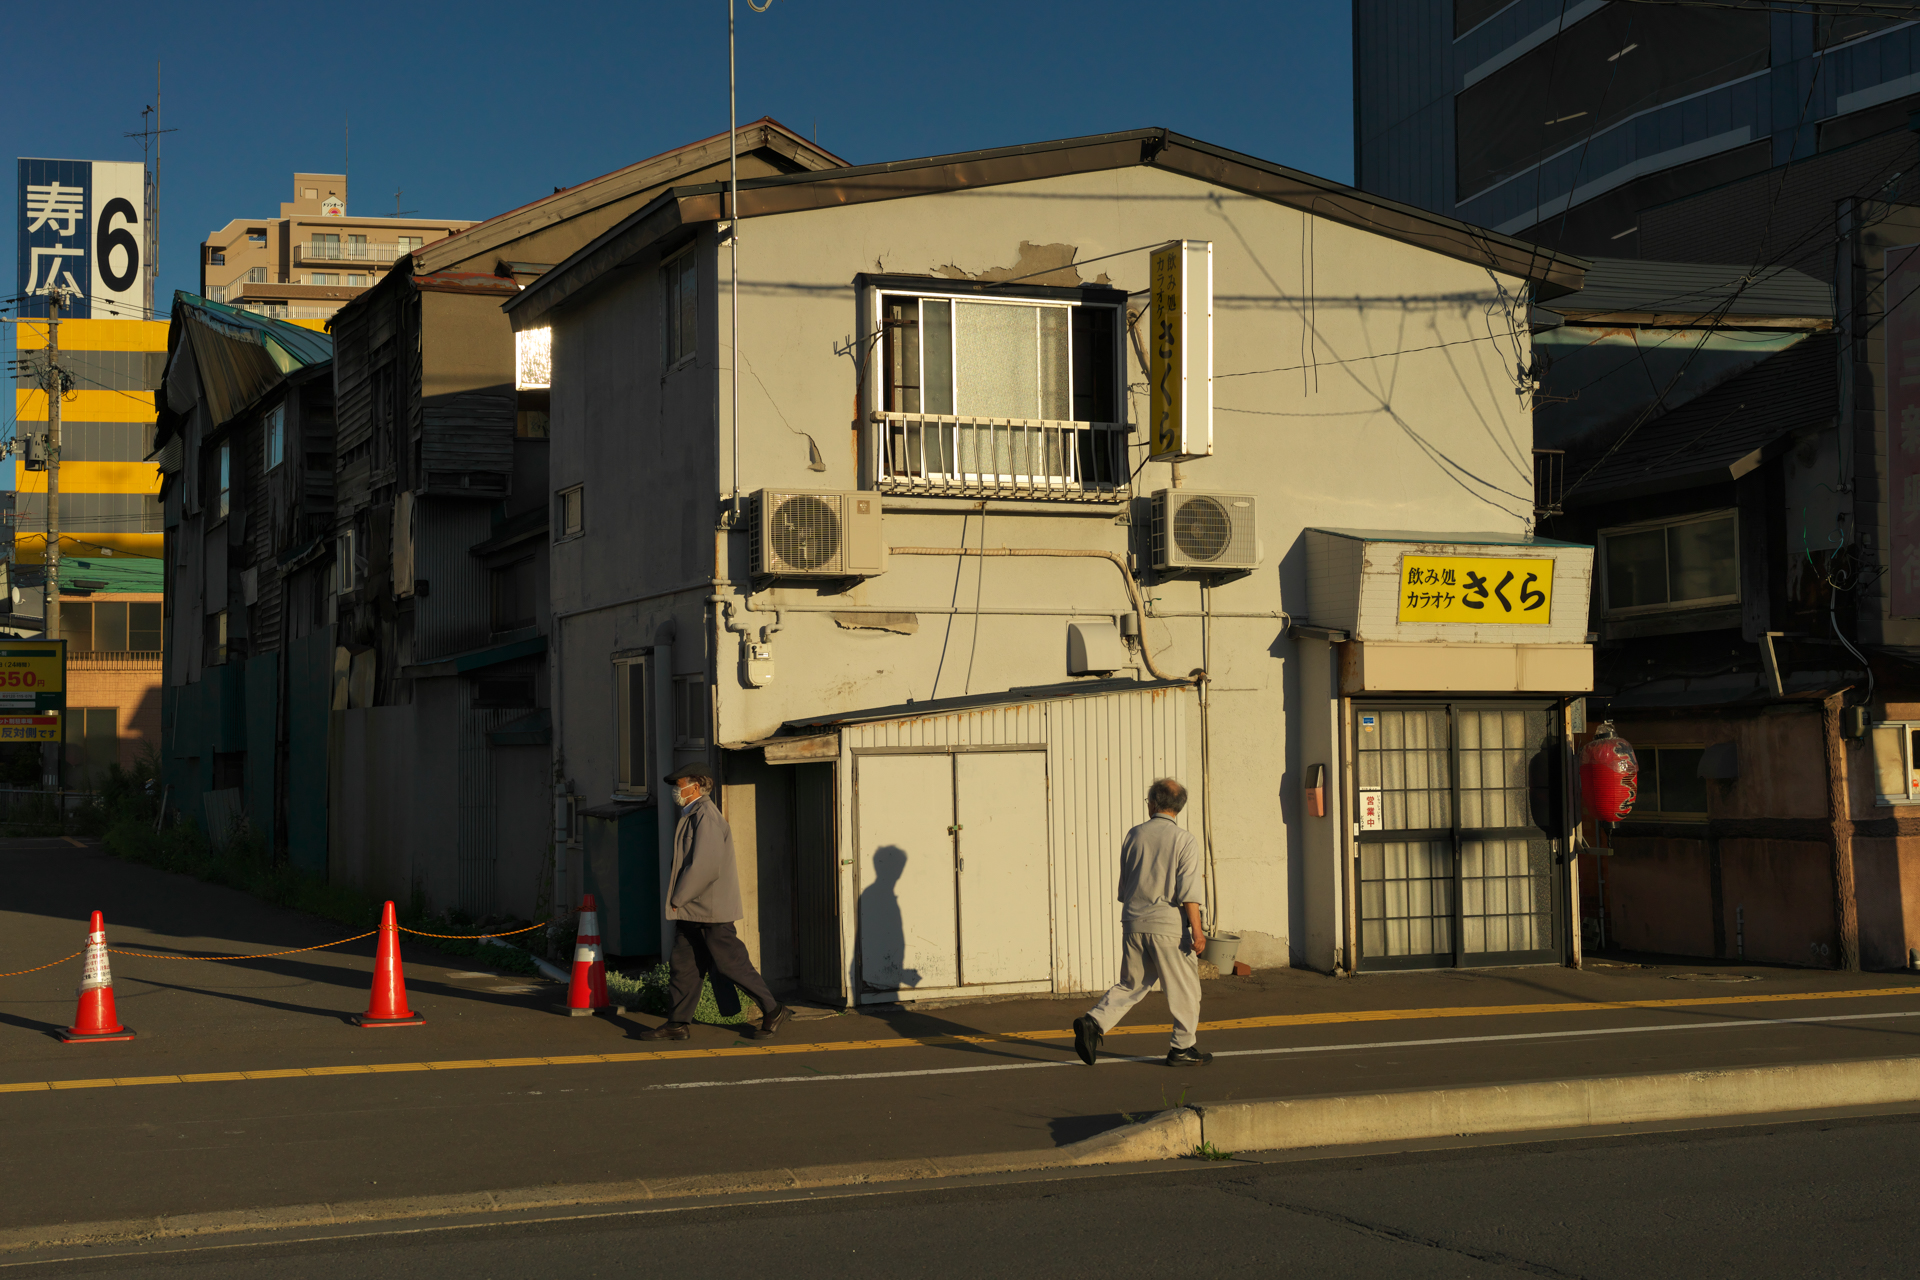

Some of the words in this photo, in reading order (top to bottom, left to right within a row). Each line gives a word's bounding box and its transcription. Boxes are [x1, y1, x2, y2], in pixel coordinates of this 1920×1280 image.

[25, 181, 85, 299] 寿広
[96, 197, 139, 293] 6
[1156, 257, 1165, 320] カラオケ
[1166, 252, 1177, 312] 飲み処
[1158, 319, 1176, 453] さくら
[1407, 567, 1456, 586] 飲み処
[1407, 591, 1455, 609] カラオケ
[1461, 570, 1546, 613] さくら
[1366, 796, 1375, 828] 営業中
